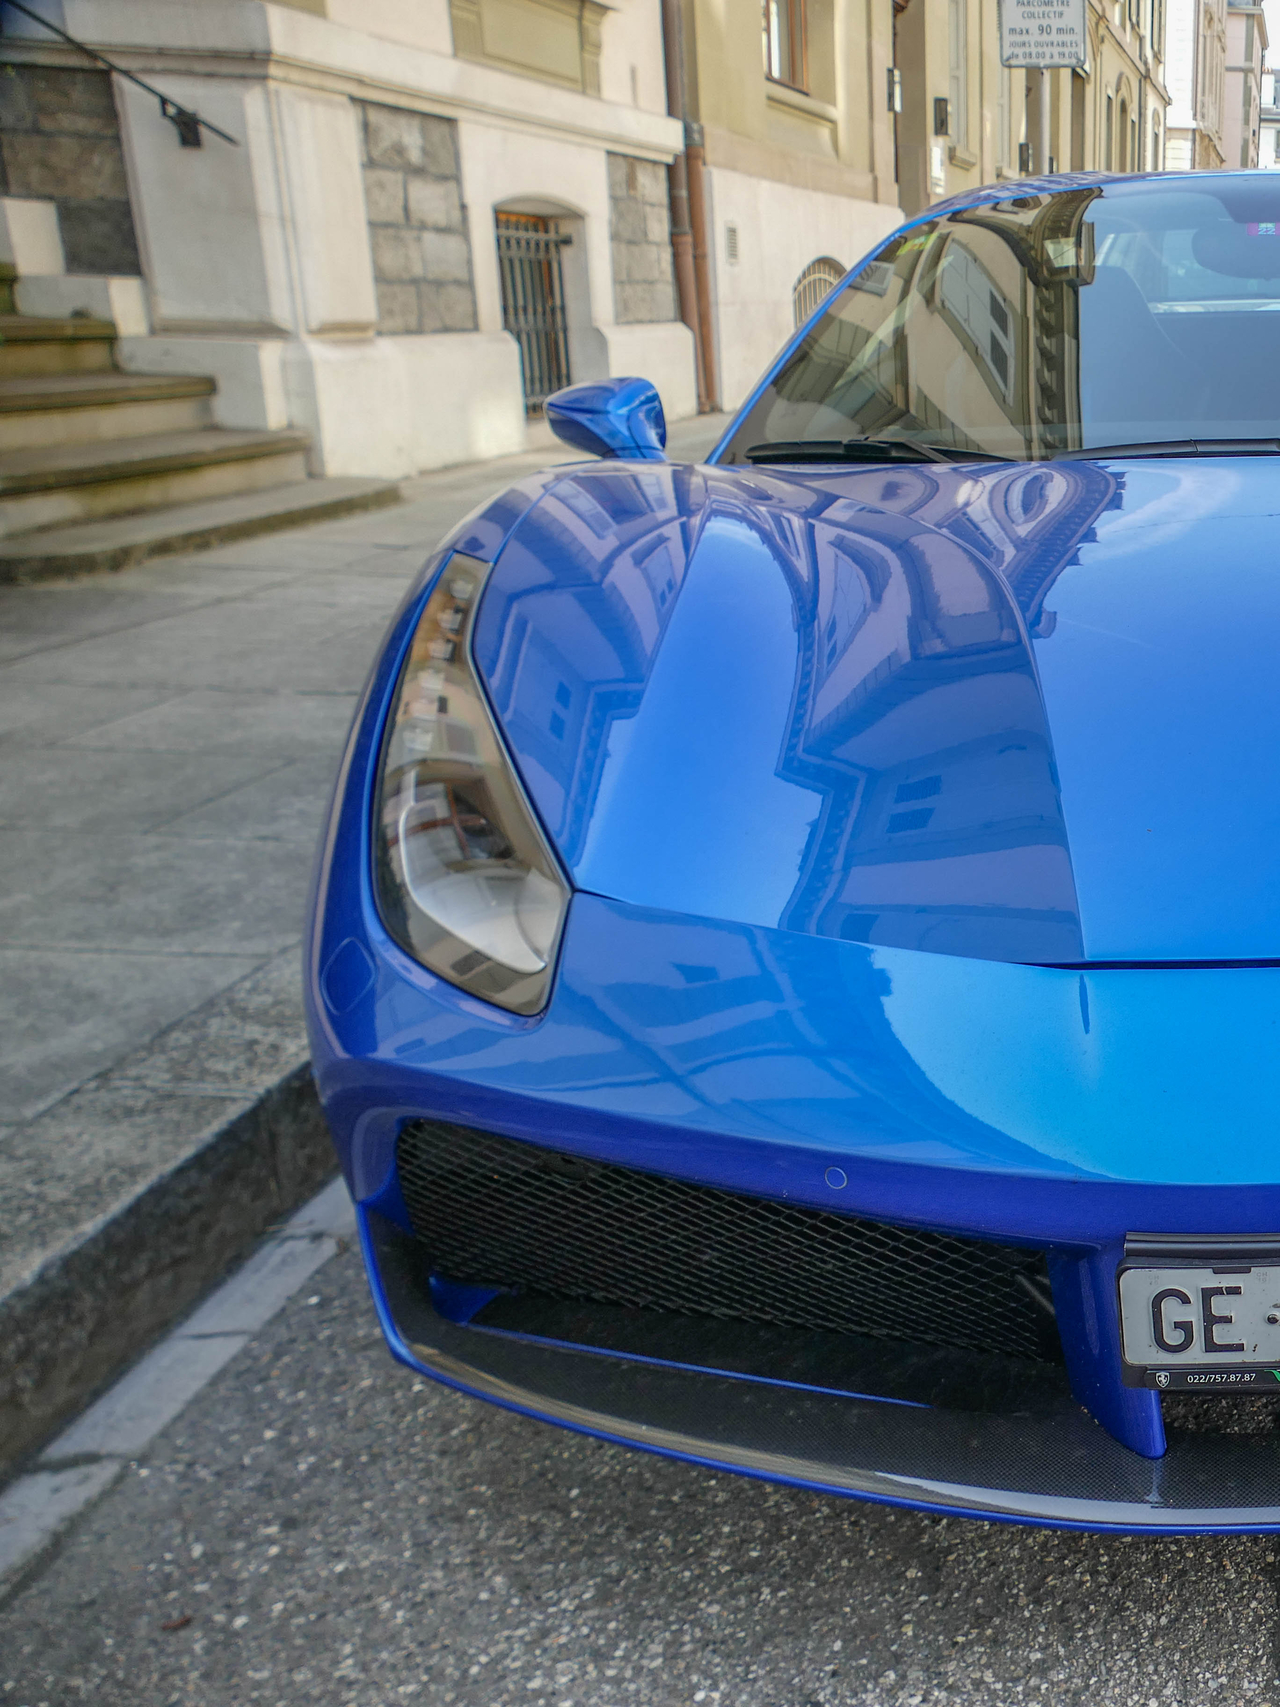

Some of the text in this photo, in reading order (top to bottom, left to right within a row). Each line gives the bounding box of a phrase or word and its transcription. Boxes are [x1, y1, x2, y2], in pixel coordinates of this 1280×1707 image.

[1022, 10, 1064, 18] COLLECTIF
[1008, 24, 1078, 35] max. 90 min.
[1008, 40, 1079, 48] JOURS OUVRABLES
[1022, 51, 1046, 59] 08.00
[1150, 1284, 1246, 1355] GE
[1187, 1373, 1256, 1384] 022/757.87.87
